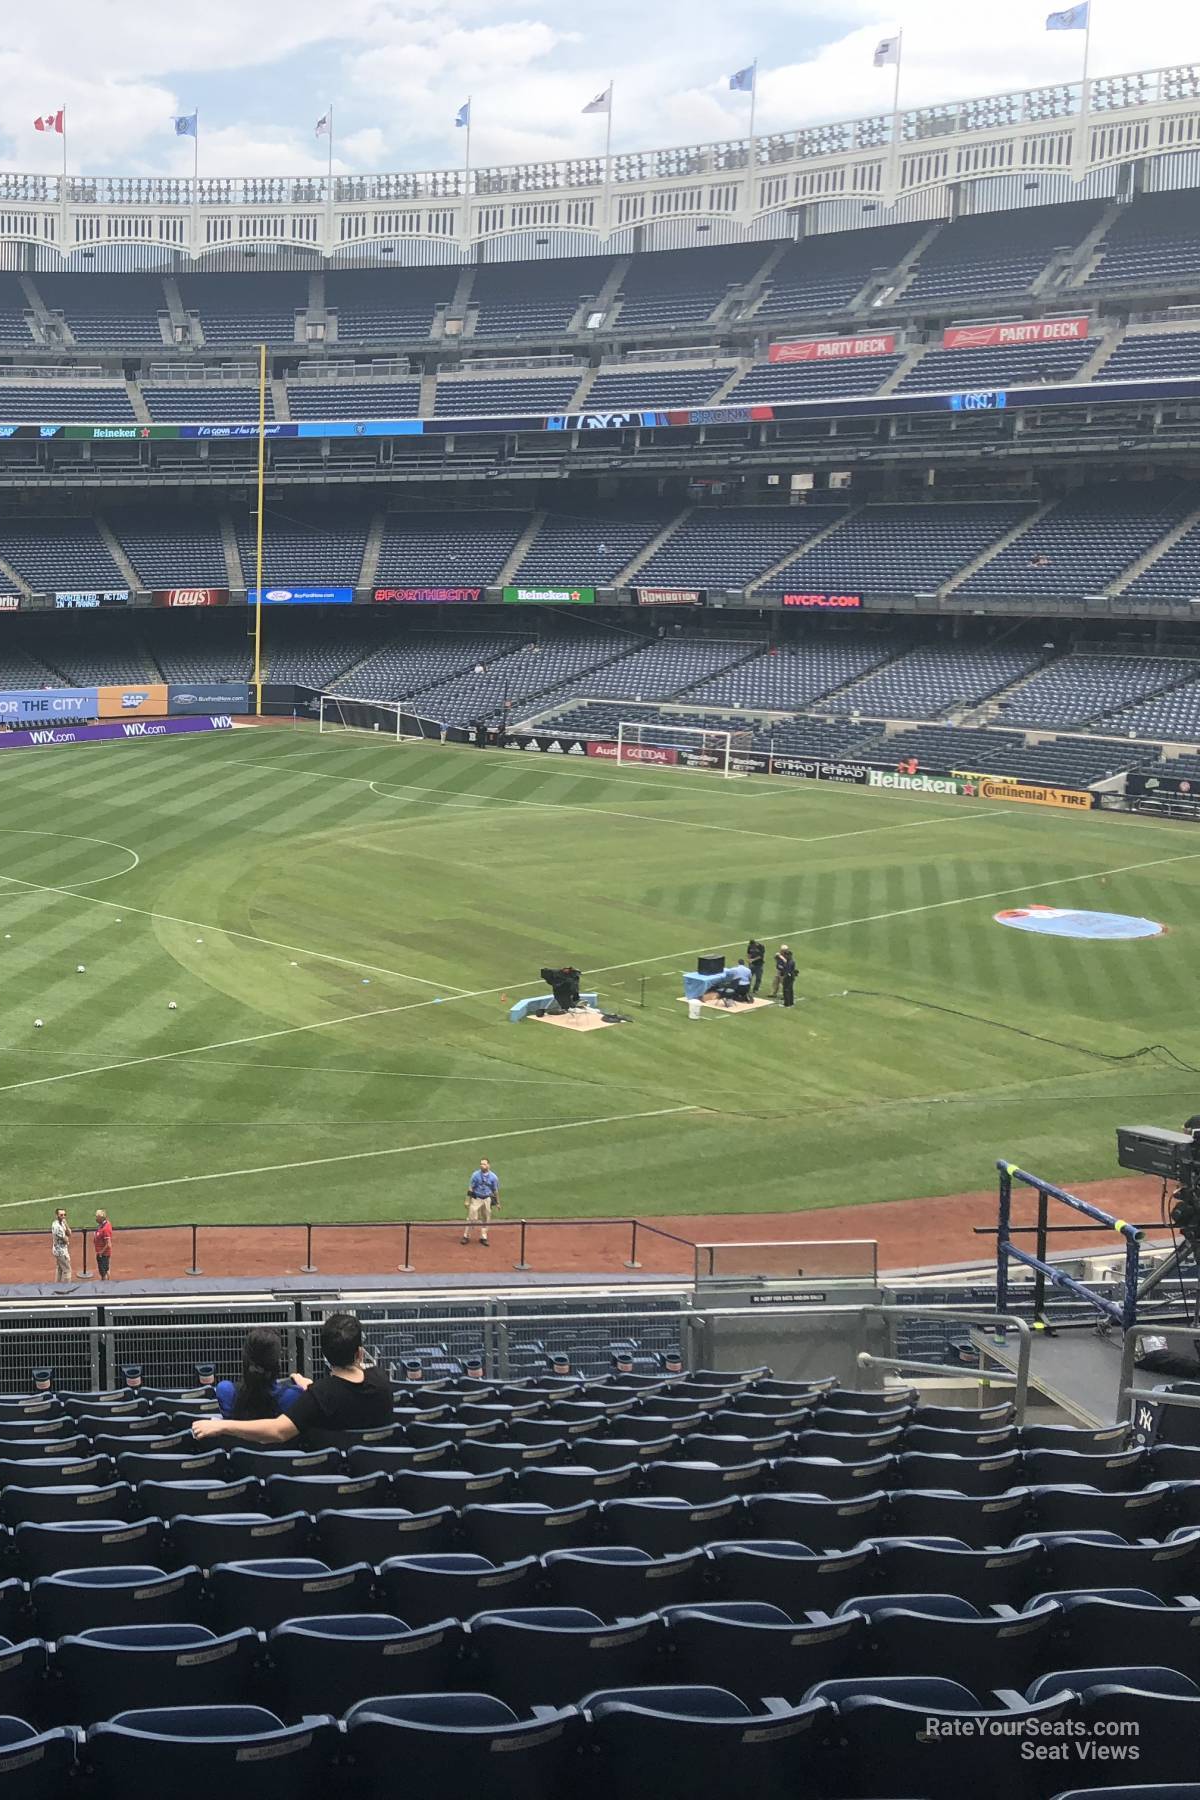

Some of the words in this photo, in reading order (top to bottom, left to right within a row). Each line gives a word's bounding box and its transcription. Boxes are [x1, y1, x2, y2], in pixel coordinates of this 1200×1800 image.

[999, 325, 1042, 341] PARTY
[1043, 322, 1080, 338] DECK
[816, 341, 854, 357] PARTY
[855, 338, 886, 353] DECK
[689, 410, 749, 424] BRONX
[40, 427, 56, 437] SAP
[94, 428, 136, 437] Heineken
[103, 593, 128, 601] ACTING
[375, 588, 482, 601] #FORTHECITY
[517, 589, 569, 601] Heineken
[784, 594, 860, 607] NYCFC.COM
[22, 699, 49, 712] THE
[53, 697, 84, 711] CITY
[121, 694, 144, 707] SAP
[774, 761, 814, 772] ETIHAD
[821, 766, 864, 778] ETIHAD
[869, 770, 957, 795] Heineken
[982, 782, 1047, 801] Continental
[1061, 794, 1087, 806] TIRE
